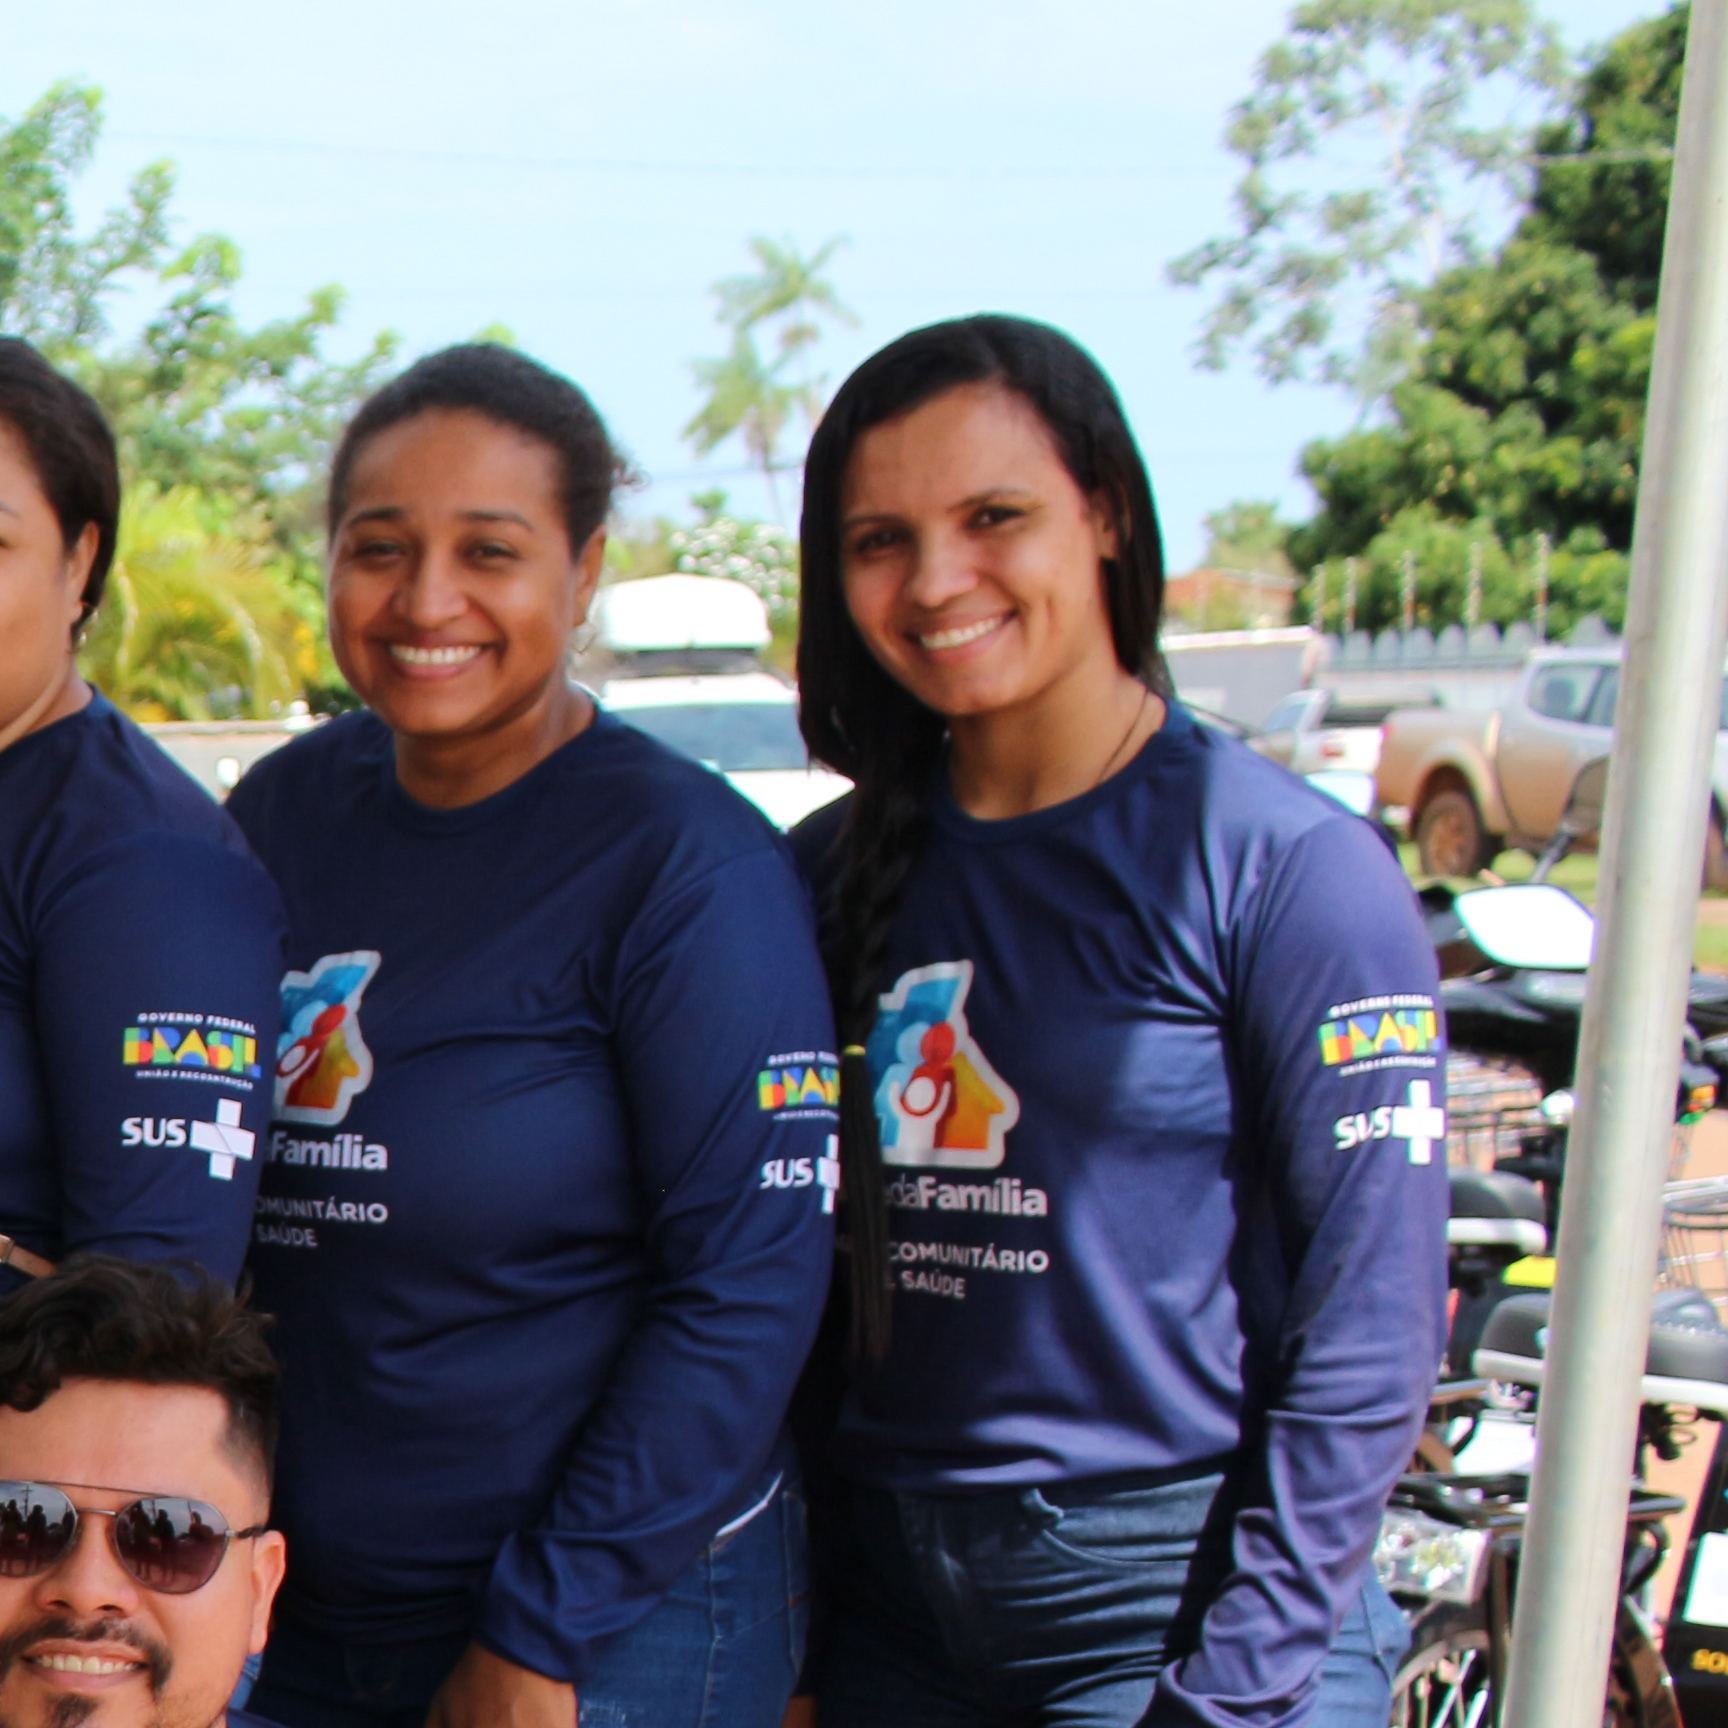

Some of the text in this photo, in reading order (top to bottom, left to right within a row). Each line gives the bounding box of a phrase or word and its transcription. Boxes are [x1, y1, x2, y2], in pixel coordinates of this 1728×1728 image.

[138, 1012, 256, 1035] GOVERNO FEDERAL
[123, 1027, 263, 1078] BRASIL
[121, 1117, 187, 1147] SUS
[760, 1157, 814, 1188] SUS
